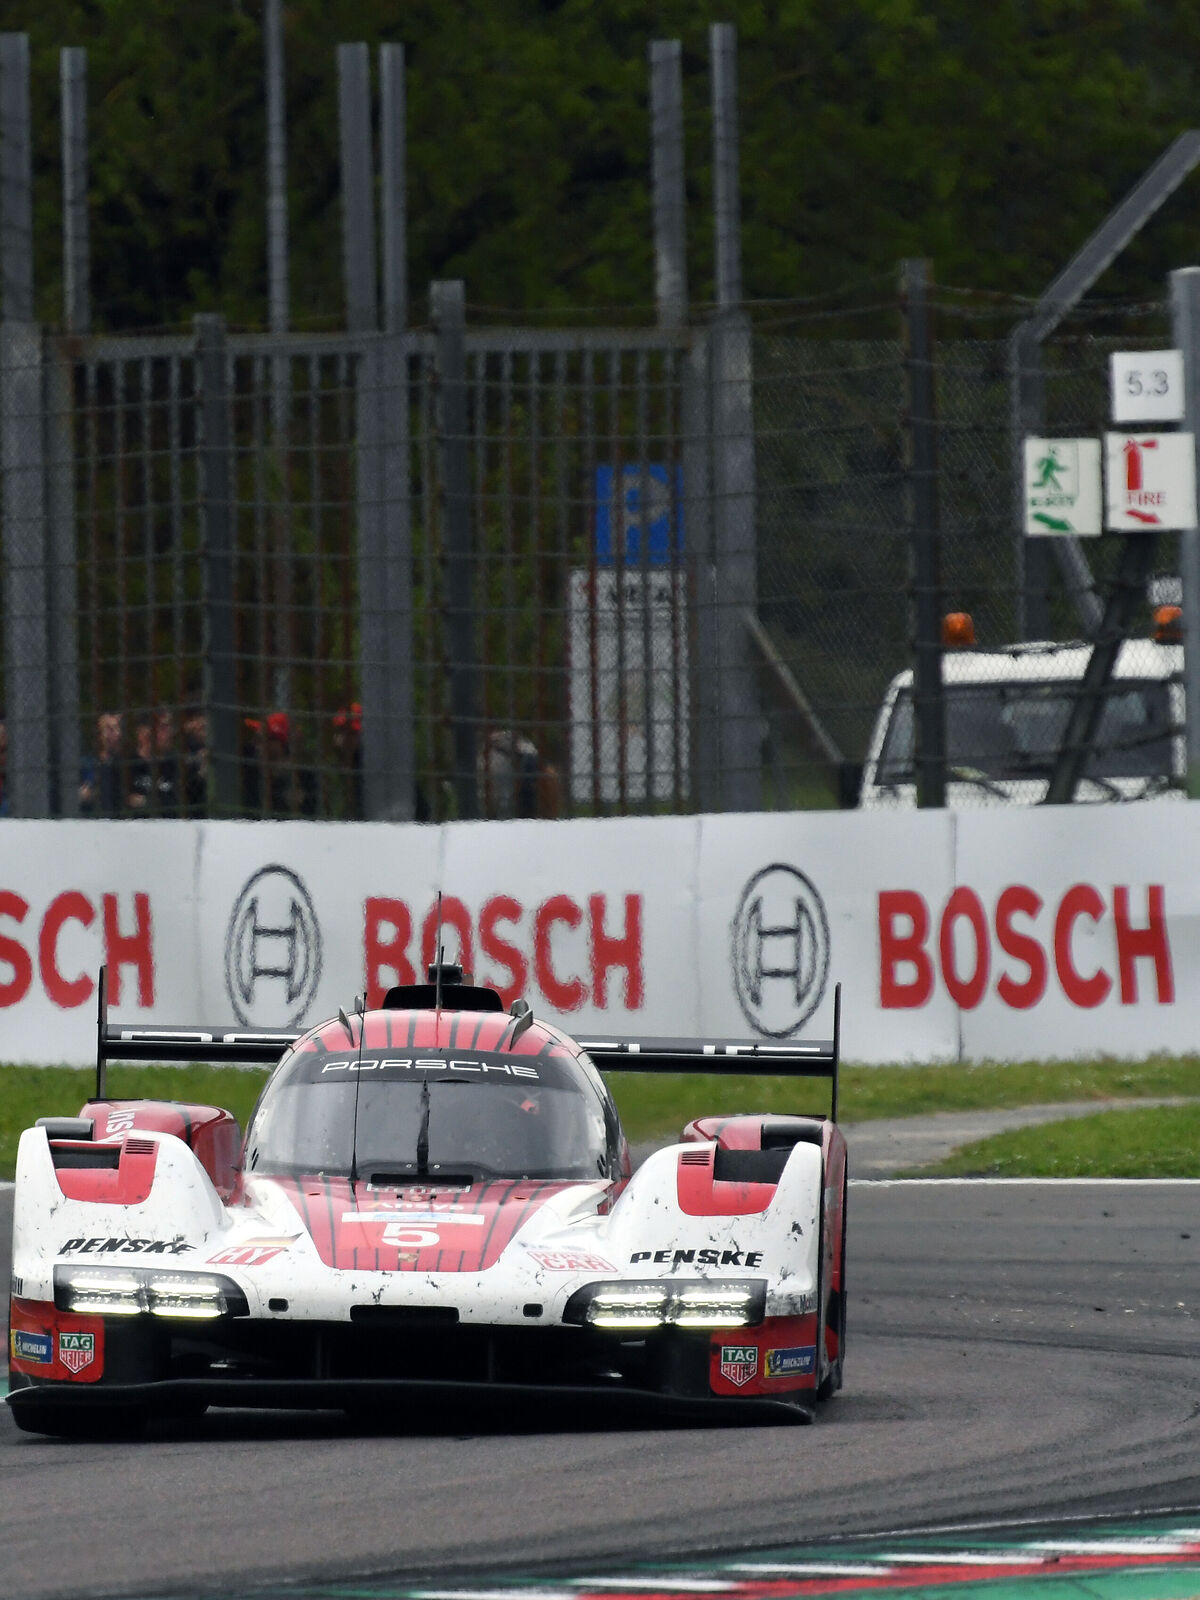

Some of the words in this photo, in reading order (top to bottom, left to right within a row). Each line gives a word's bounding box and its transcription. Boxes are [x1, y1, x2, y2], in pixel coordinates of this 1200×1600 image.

[1127, 370, 1169, 396] 5.3
[1127, 491, 1165, 506] FIRE
[365, 895, 642, 1011] BOSCH
[879, 885, 1172, 1009] BOSCH
[320, 1058, 539, 1080] PORSCHE
[381, 1222, 440, 1247] 5
[57, 1237, 196, 1255] PENSKE
[542, 1258, 611, 1270] CAR
[630, 1249, 764, 1268] PENSKE
[21, 1341, 47, 1355] MICHELIN
[61, 1335, 91, 1349] TAG
[60, 1350, 92, 1370] HEUER
[724, 1349, 755, 1362] TAG
[723, 1363, 756, 1383] HEUER
